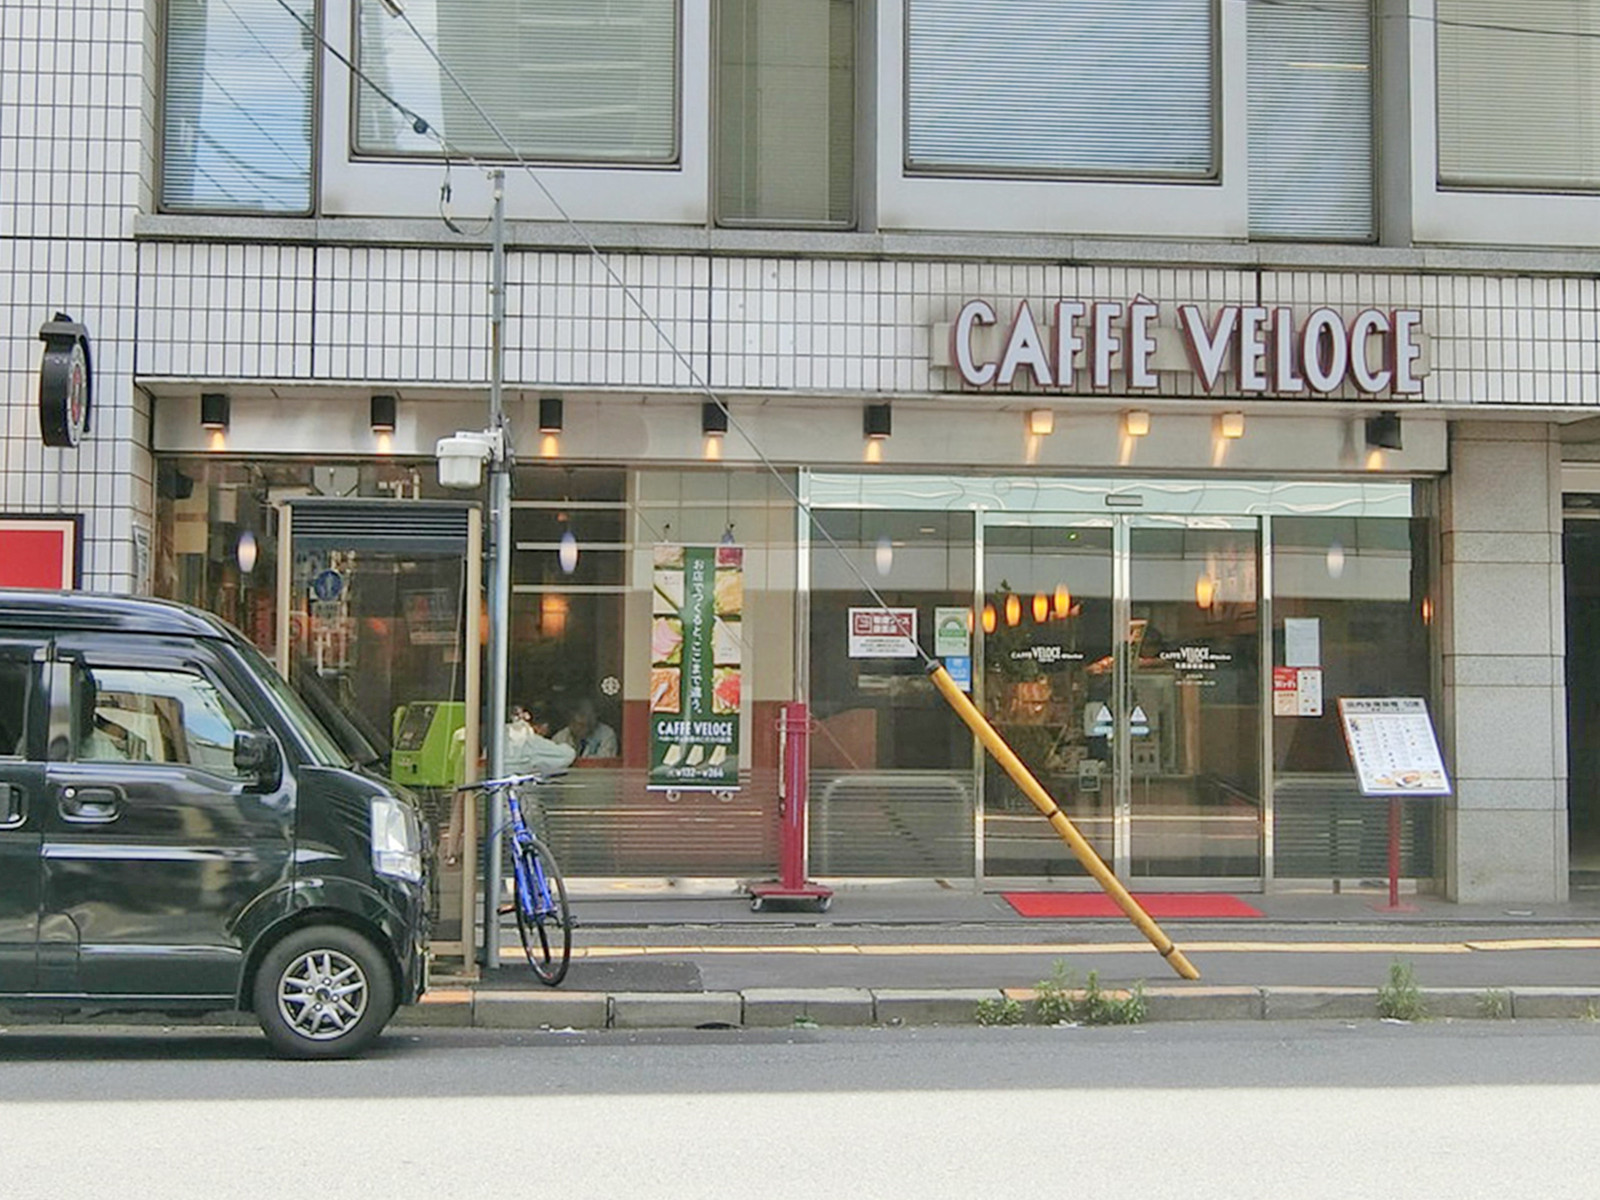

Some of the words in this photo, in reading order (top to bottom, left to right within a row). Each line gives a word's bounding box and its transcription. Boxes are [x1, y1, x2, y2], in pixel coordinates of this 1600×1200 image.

[954, 293, 1159, 389] CAFFÈ
[1177, 305, 1422, 394] VELOCE
[693, 721, 733, 736] VELOCE
